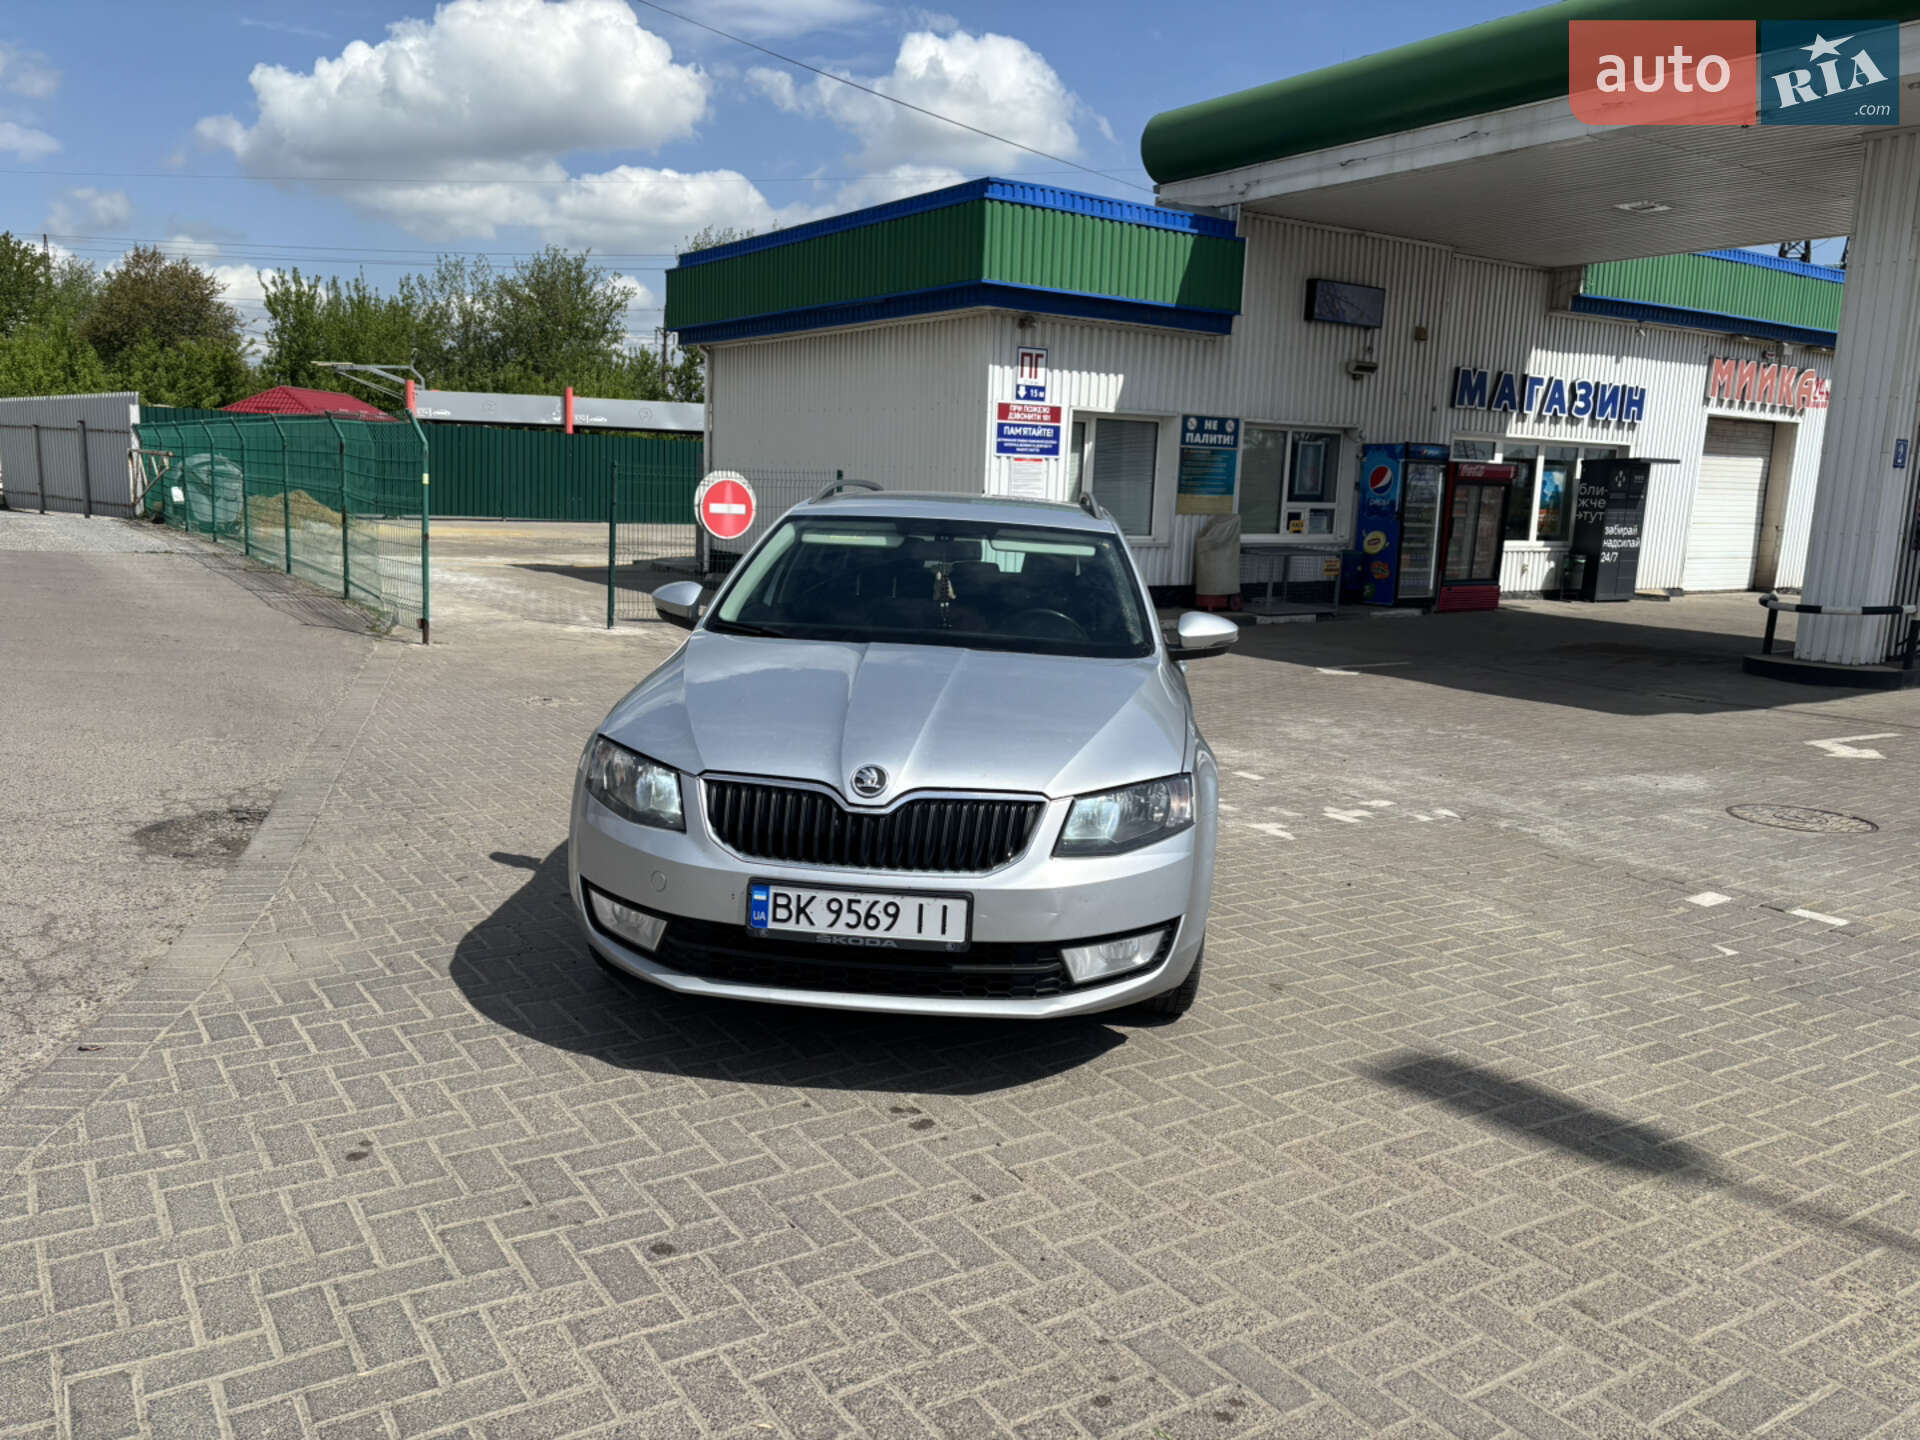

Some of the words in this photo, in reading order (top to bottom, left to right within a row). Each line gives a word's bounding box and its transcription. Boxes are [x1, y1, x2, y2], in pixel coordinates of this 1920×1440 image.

[1020, 351, 1045, 379] ПГ
[1455, 367, 1647, 423] МАГАЗИН
[1204, 419, 1218, 431] НЕ
[1185, 432, 1235, 446] ПАЛИТИ!
[1577, 498, 1607, 509] жче
[1604, 525, 1639, 538] забирай
[1602, 537, 1641, 549] надсилай
[1600, 551, 1619, 563] 24/7
[753, 910, 766, 921] UA
[771, 892, 817, 927] BK
[826, 897, 901, 932] 9569
